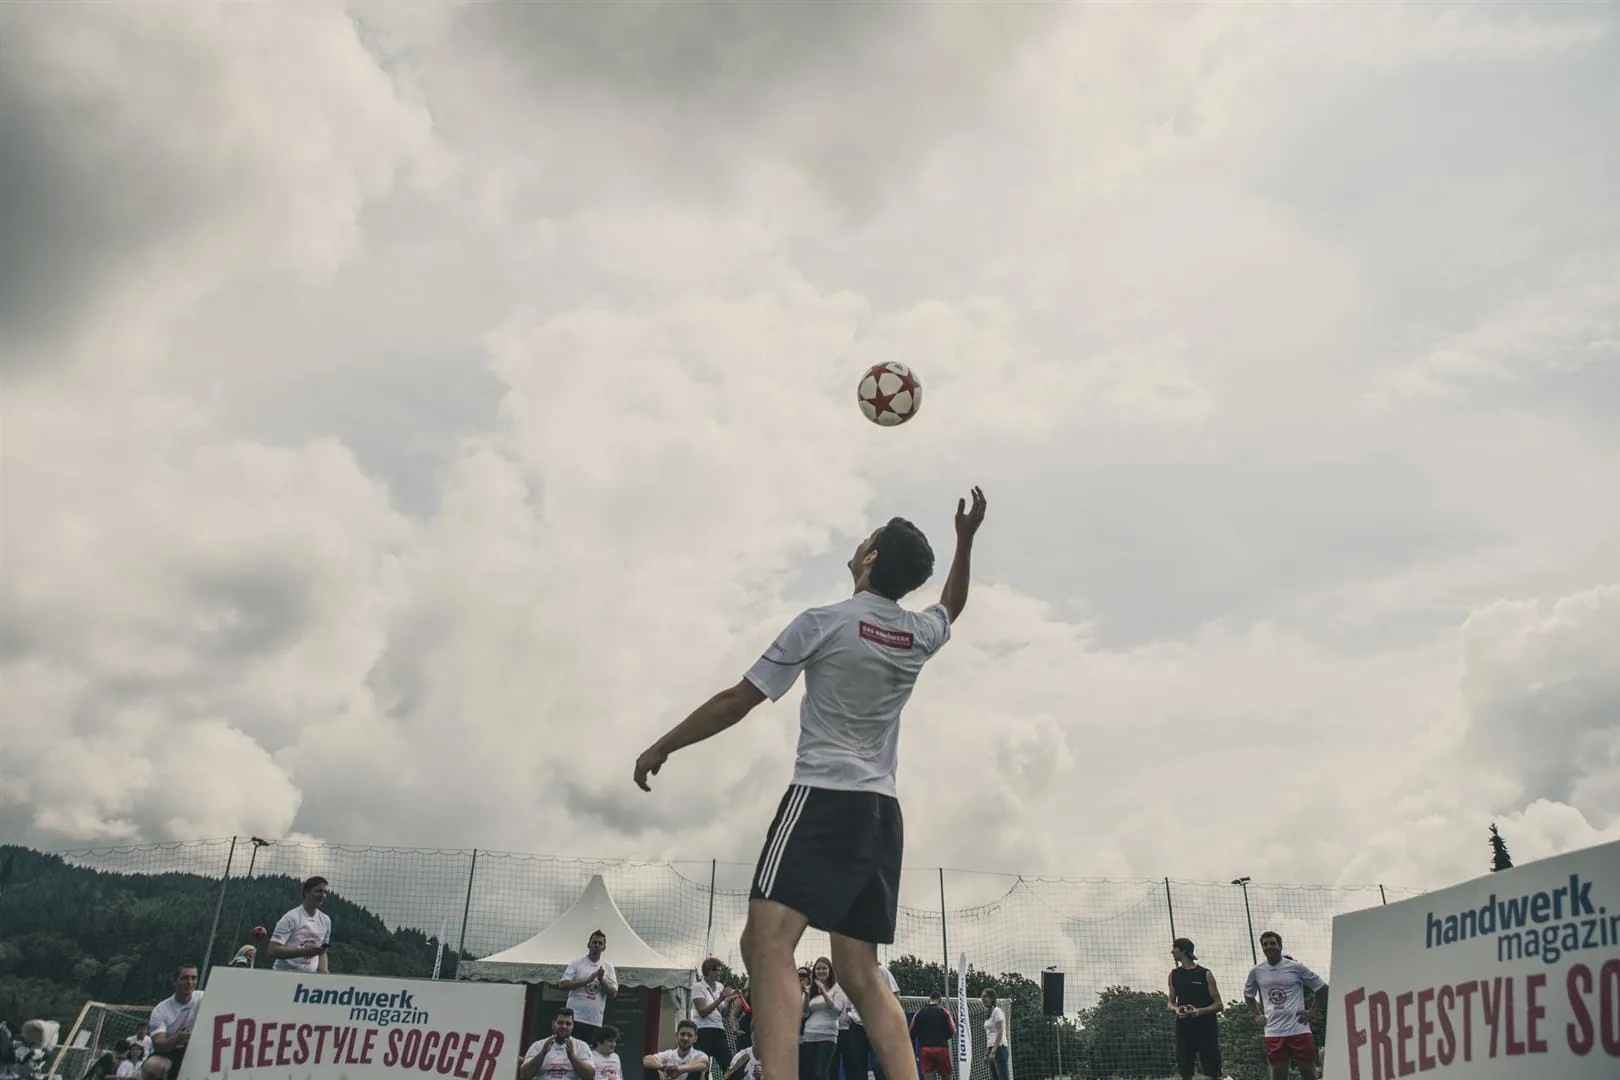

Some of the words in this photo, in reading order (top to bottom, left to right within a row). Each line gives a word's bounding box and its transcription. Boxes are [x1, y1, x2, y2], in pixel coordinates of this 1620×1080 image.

[1426, 874, 1594, 949] handwerk
[293, 984, 414, 1010] handwerk
[349, 1006, 430, 1027] magazin
[1344, 973, 1549, 1080] FREESTYLE
[210, 1013, 379, 1073] FREESTYLE
[383, 1028, 505, 1080] SOCCER
